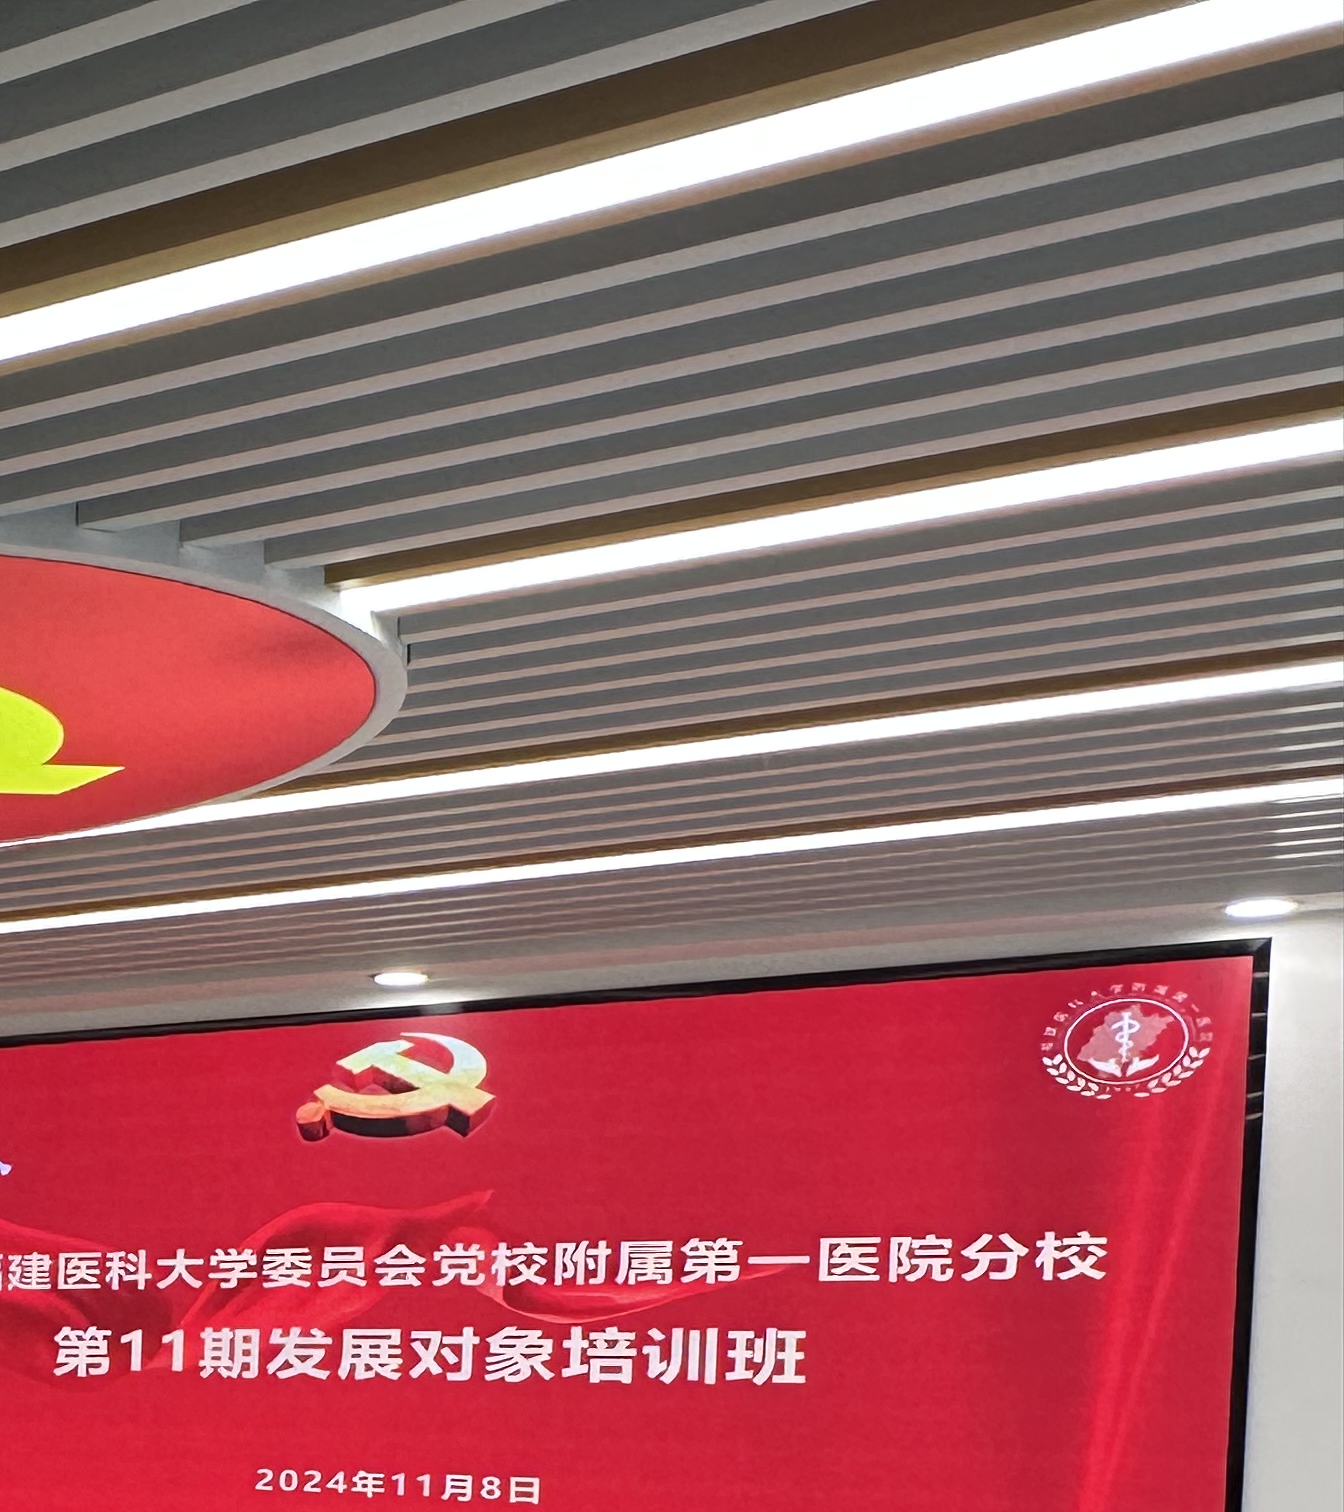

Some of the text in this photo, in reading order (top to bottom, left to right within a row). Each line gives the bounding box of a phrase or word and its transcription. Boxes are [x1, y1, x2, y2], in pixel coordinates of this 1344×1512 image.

[52, 1325, 808, 1386] 第11期发展对象培训班
[254, 1468, 541, 1505] 2024年11月8日
